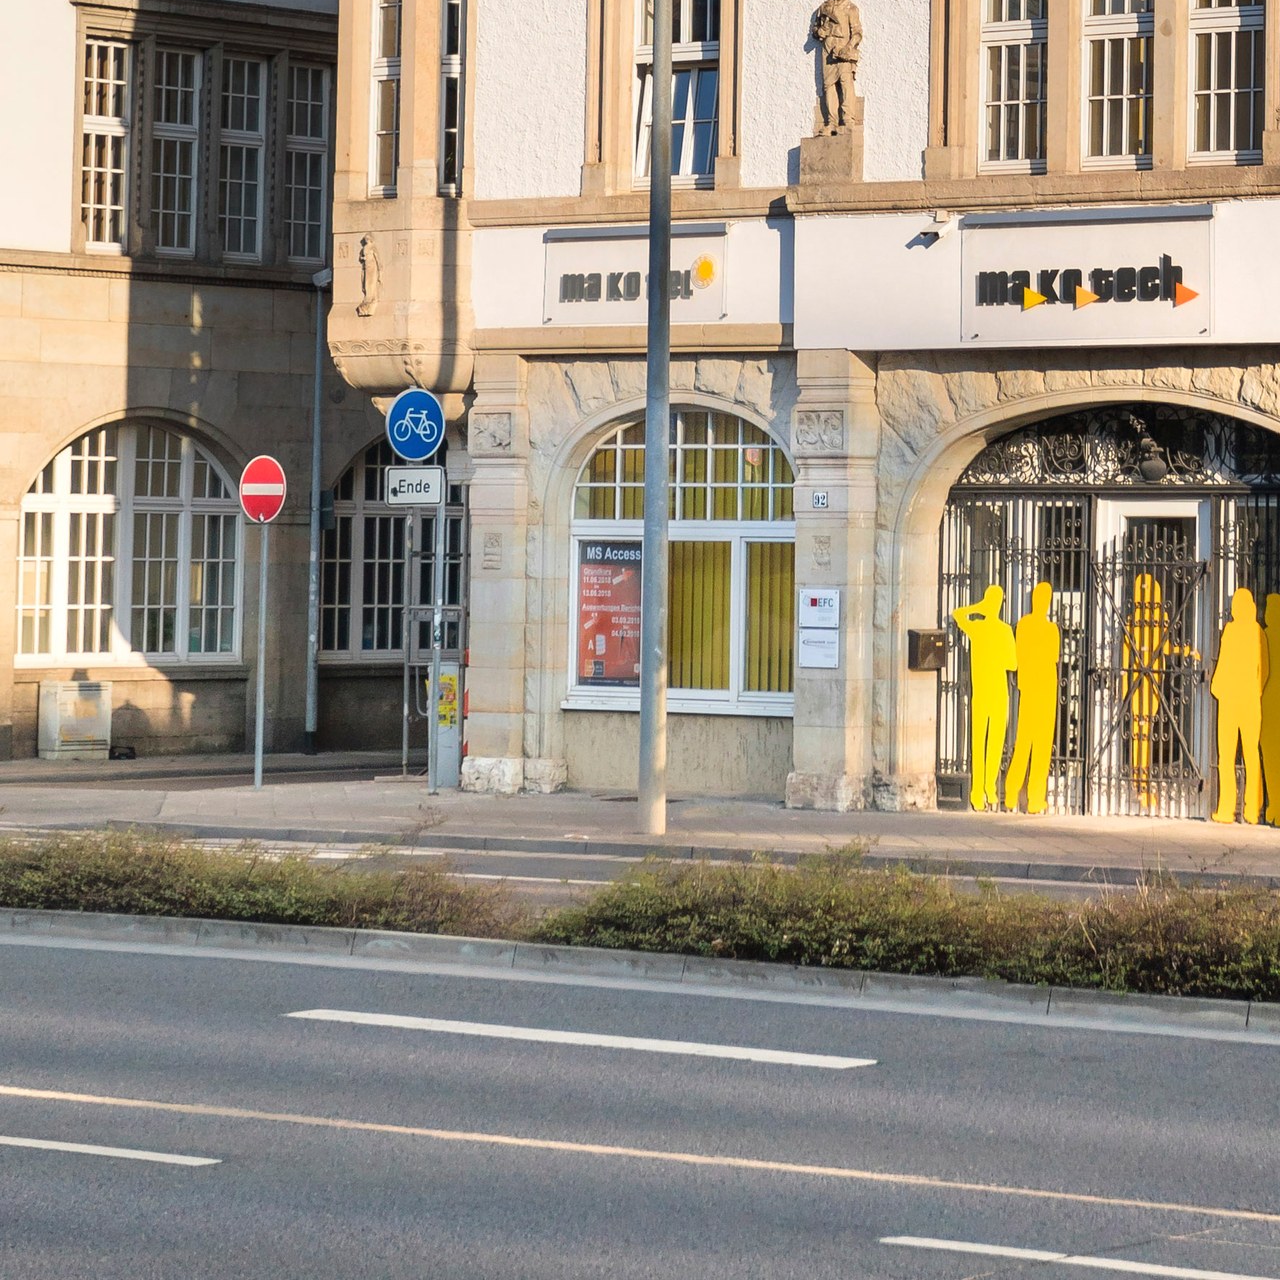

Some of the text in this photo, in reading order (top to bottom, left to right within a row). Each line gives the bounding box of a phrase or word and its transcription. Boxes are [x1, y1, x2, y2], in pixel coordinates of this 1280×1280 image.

[399, 479, 430, 494] Ende
[814, 493, 827, 506] 92
[586, 547, 641, 561] MS Access
[818, 597, 834, 607] EFC
